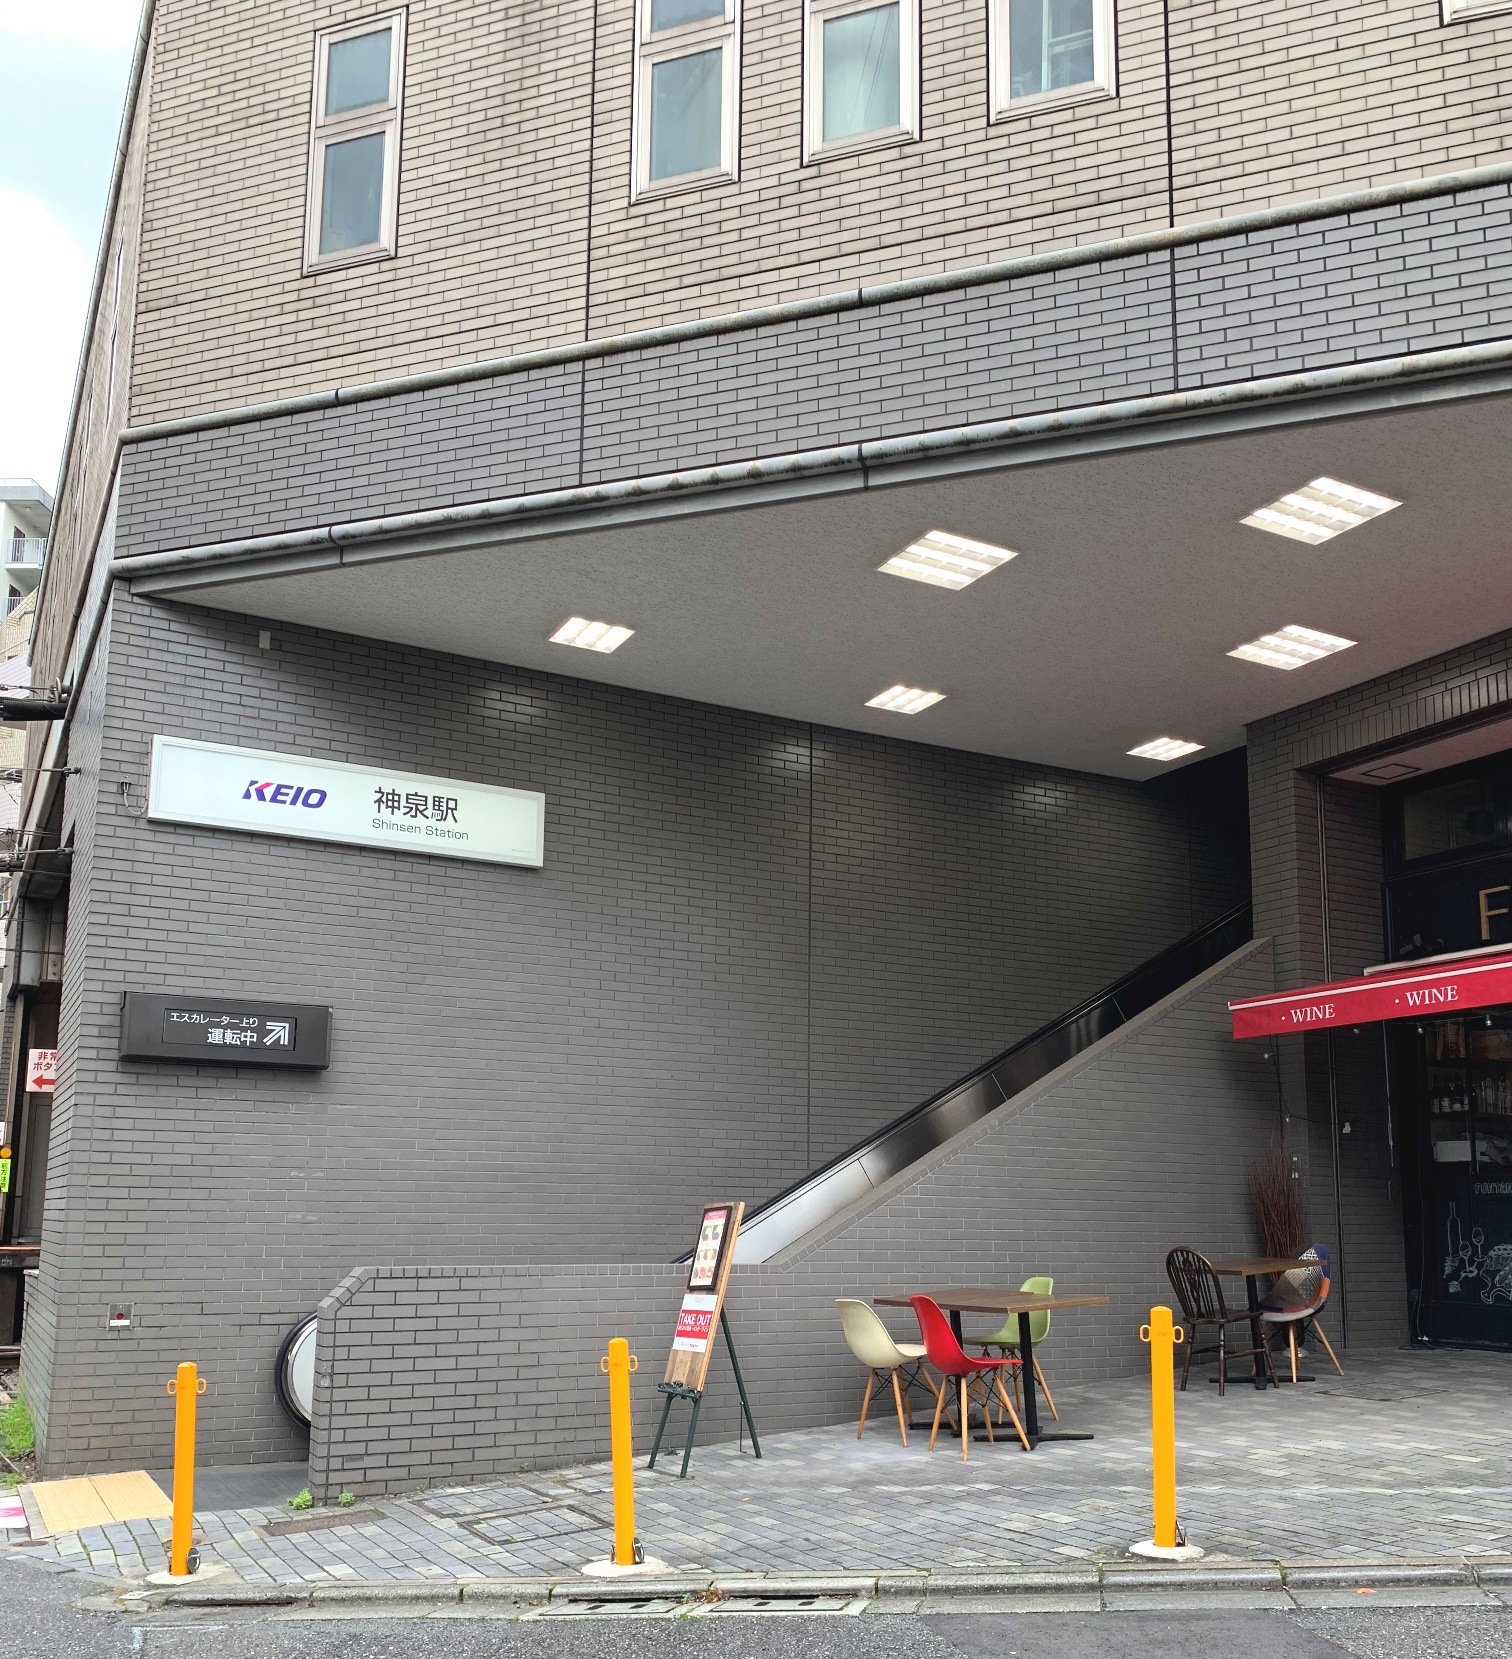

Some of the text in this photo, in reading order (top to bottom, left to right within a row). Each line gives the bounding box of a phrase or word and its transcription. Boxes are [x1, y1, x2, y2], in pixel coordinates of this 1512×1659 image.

[242, 780, 327, 809] KEIO
[373, 786, 458, 824] 神泉駅
[372, 818, 469, 840] Shinsen Station
[1290, 985, 1459, 1024] WINE WINE
[170, 1012, 258, 1027] エスカレーター上り
[207, 1028, 257, 1046] 運転中
[33, 1061, 57, 1072] ボタ
[681, 1313, 711, 1326] TAKE OUT
